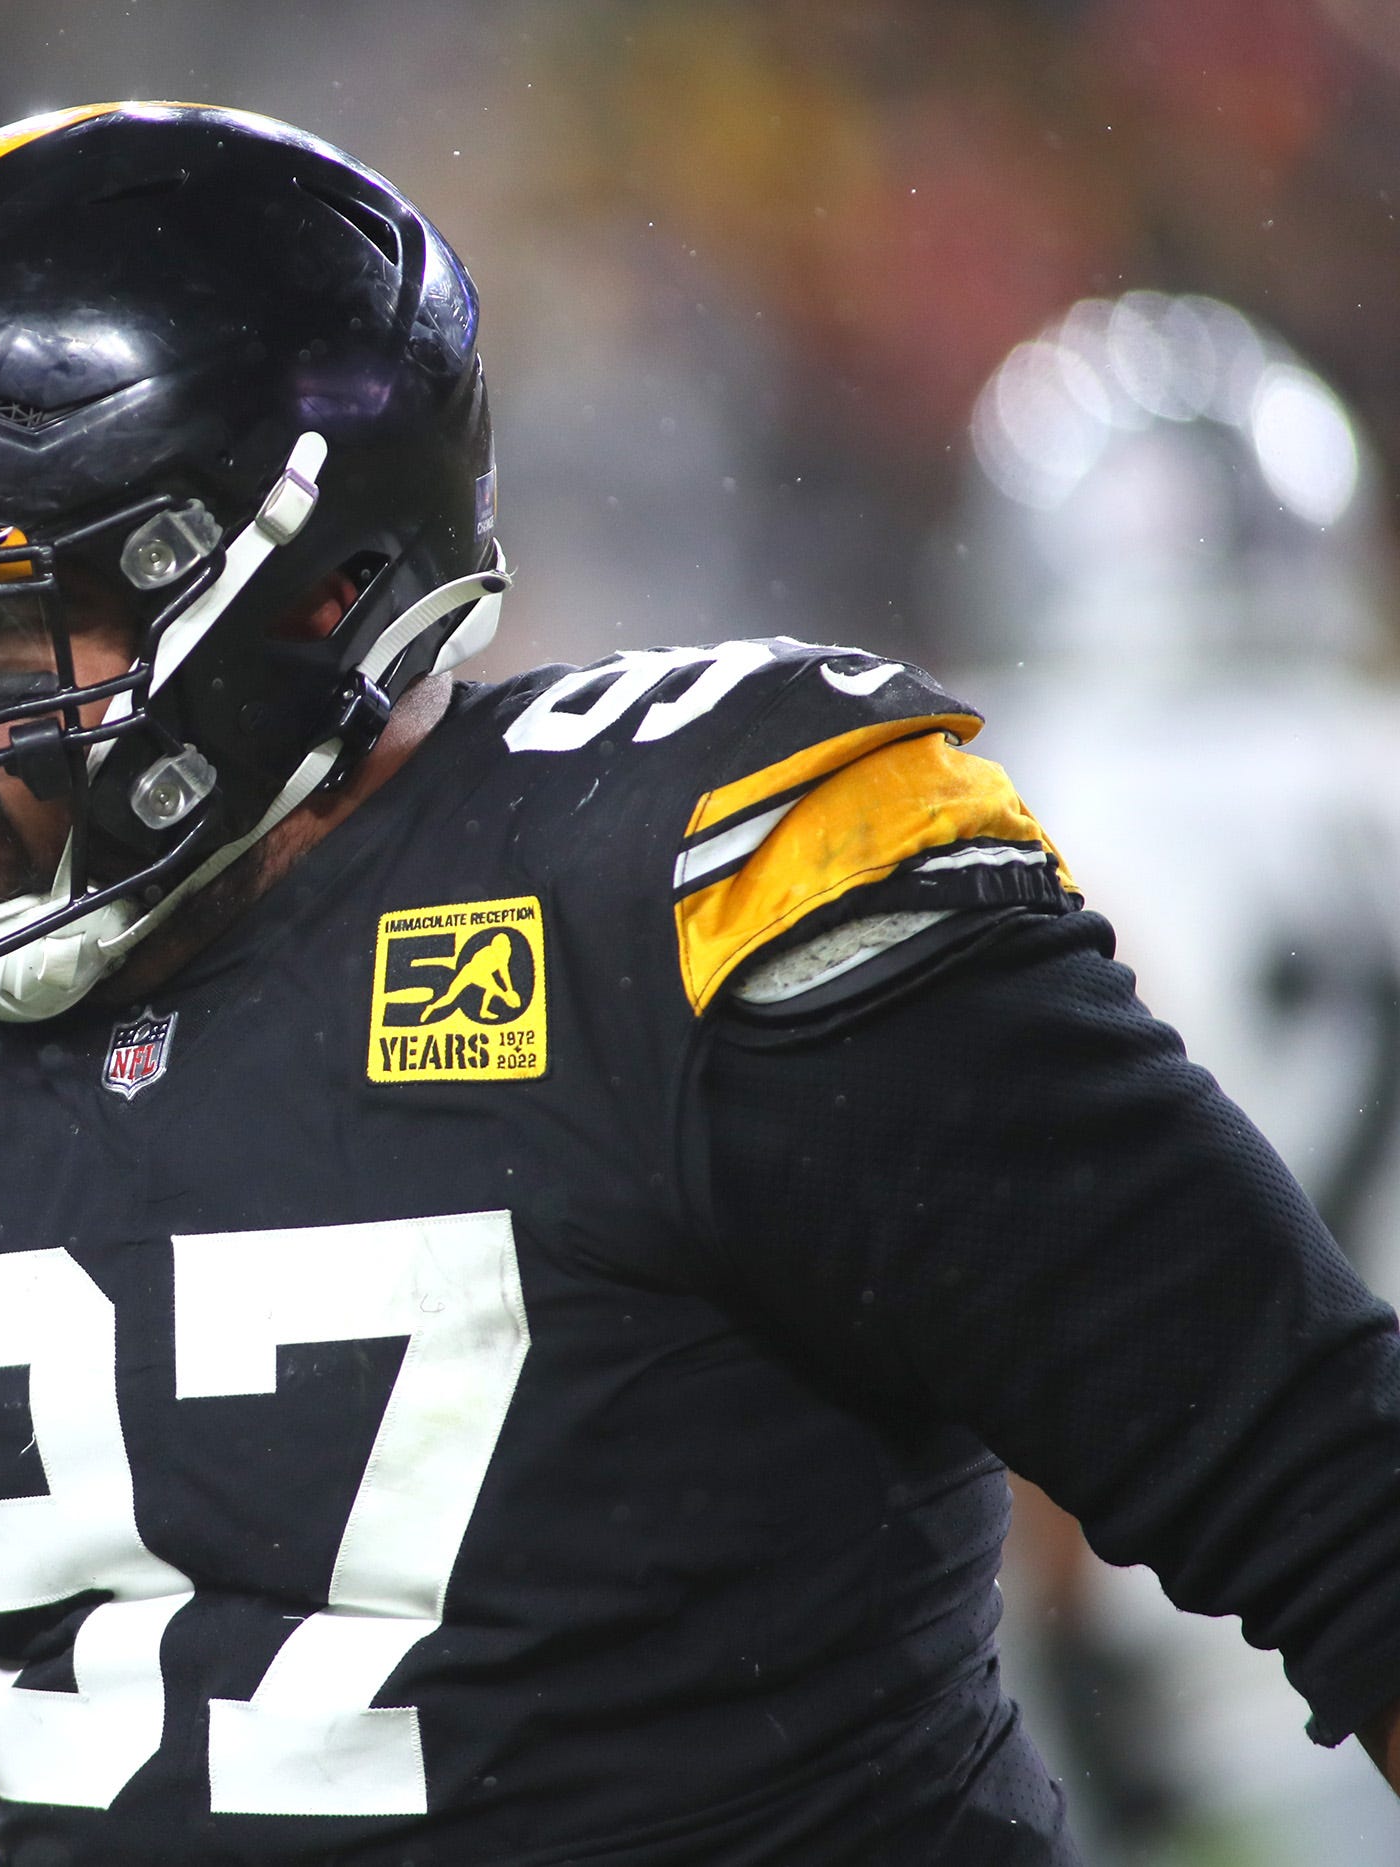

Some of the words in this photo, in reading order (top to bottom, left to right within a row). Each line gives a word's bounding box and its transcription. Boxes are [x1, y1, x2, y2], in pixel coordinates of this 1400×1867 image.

[502, 636, 879, 753] 9
[385, 912, 468, 933] IMMACULATE
[470, 906, 535, 926] RECEPTION
[382, 926, 536, 1027] 50
[110, 1043, 157, 1080] NFL
[379, 1032, 490, 1072] YEARS
[499, 1030, 535, 1047] 1972
[497, 1053, 537, 1070] 2022
